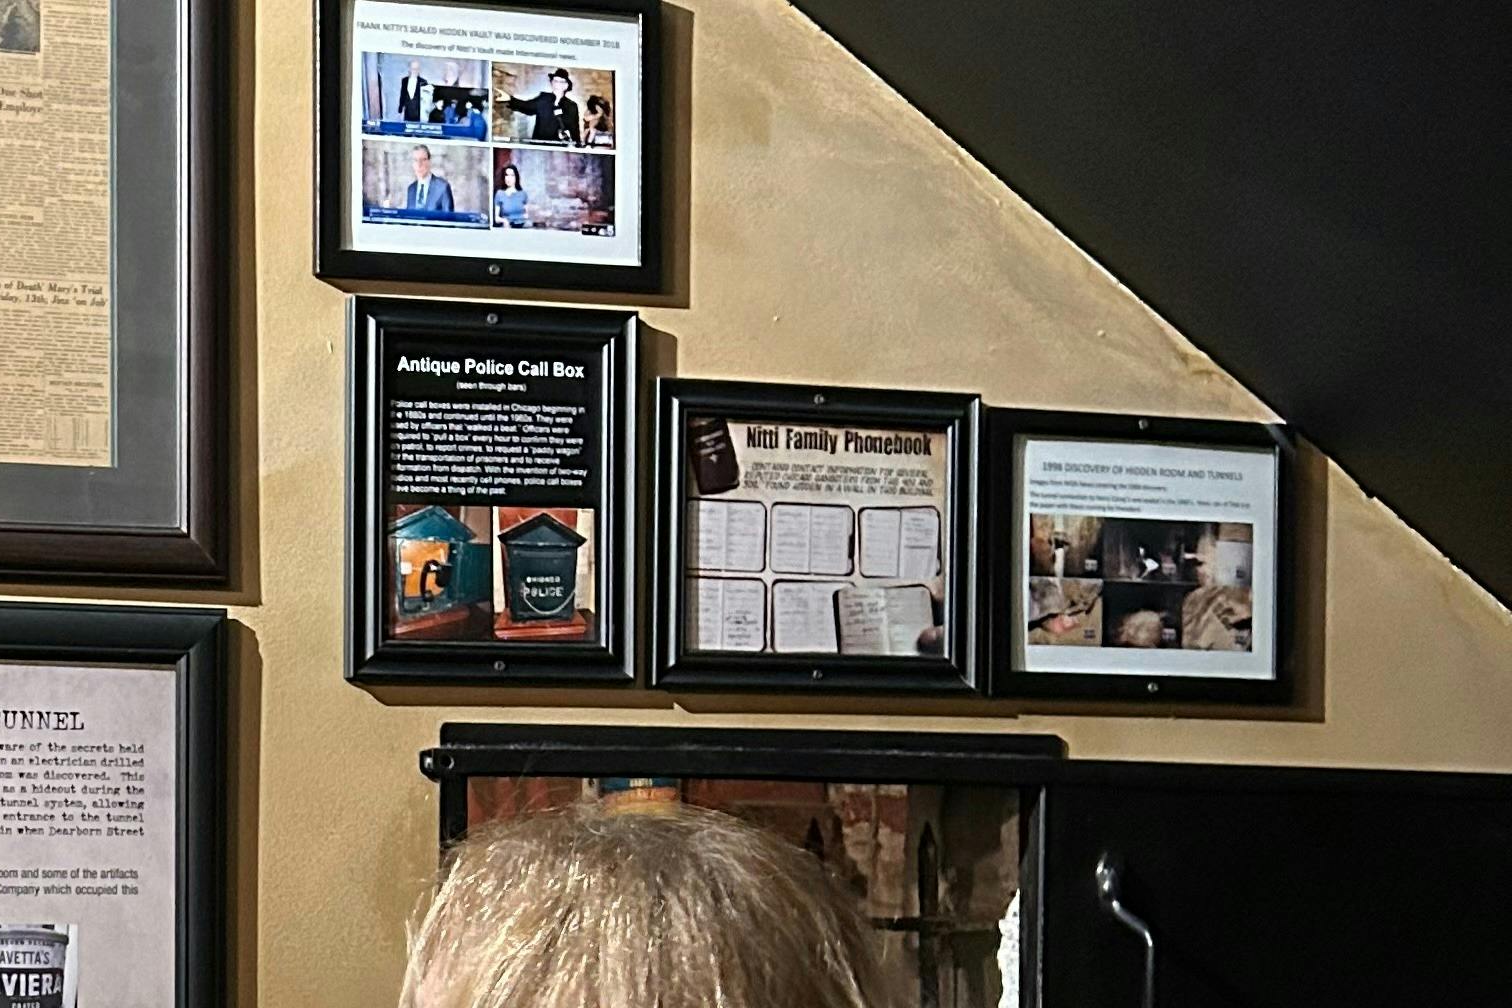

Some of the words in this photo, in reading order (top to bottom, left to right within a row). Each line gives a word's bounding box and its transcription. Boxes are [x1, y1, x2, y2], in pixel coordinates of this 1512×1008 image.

[397, 356, 460, 376] Antique
[464, 358, 514, 375] Police
[518, 361, 549, 377] Call
[553, 362, 584, 378] Box
[746, 426, 779, 449] Nitti
[786, 428, 838, 454] Family
[844, 431, 932, 456] Phonebook
[523, 586, 564, 598] POLICE
[29, 742, 42, 752] of
[48, 742, 67, 753] the
[71, 743, 114, 753] secrets
[119, 744, 145, 754] held
[11, 758, 24, 766] an
[29, 757, 97, 767] electrician
[100, 758, 145, 768] drilled
[18, 772, 38, 780] was
[43, 771, 110, 781] discovered.
[120, 773, 145, 782] This
[32, 784, 76, 795] hideout
[81, 785, 121, 796] during
[126, 786, 145, 795] the
[0, 798, 39, 808] tunnel
[44, 800, 87, 810] system,
[92, 799, 145, 810] allowing
[2, 813, 55, 822] entrance
[62, 813, 74, 822] to
[81, 813, 100, 823] the
[106, 813, 145, 823] tunnel
[0, 825, 12, 835] in
[17, 825, 45, 836] when
[48, 826, 102, 836] Dearborn
[107, 826, 145, 837] Street
[21, 868, 39, 879] and
[41, 870, 68, 879] some
[70, 868, 81, 879] of
[82, 868, 98, 879] the
[100, 868, 139, 880] artifacts
[43, 884, 72, 895] which
[75, 885, 119, 898] occupied
[121, 884, 139, 896] this
